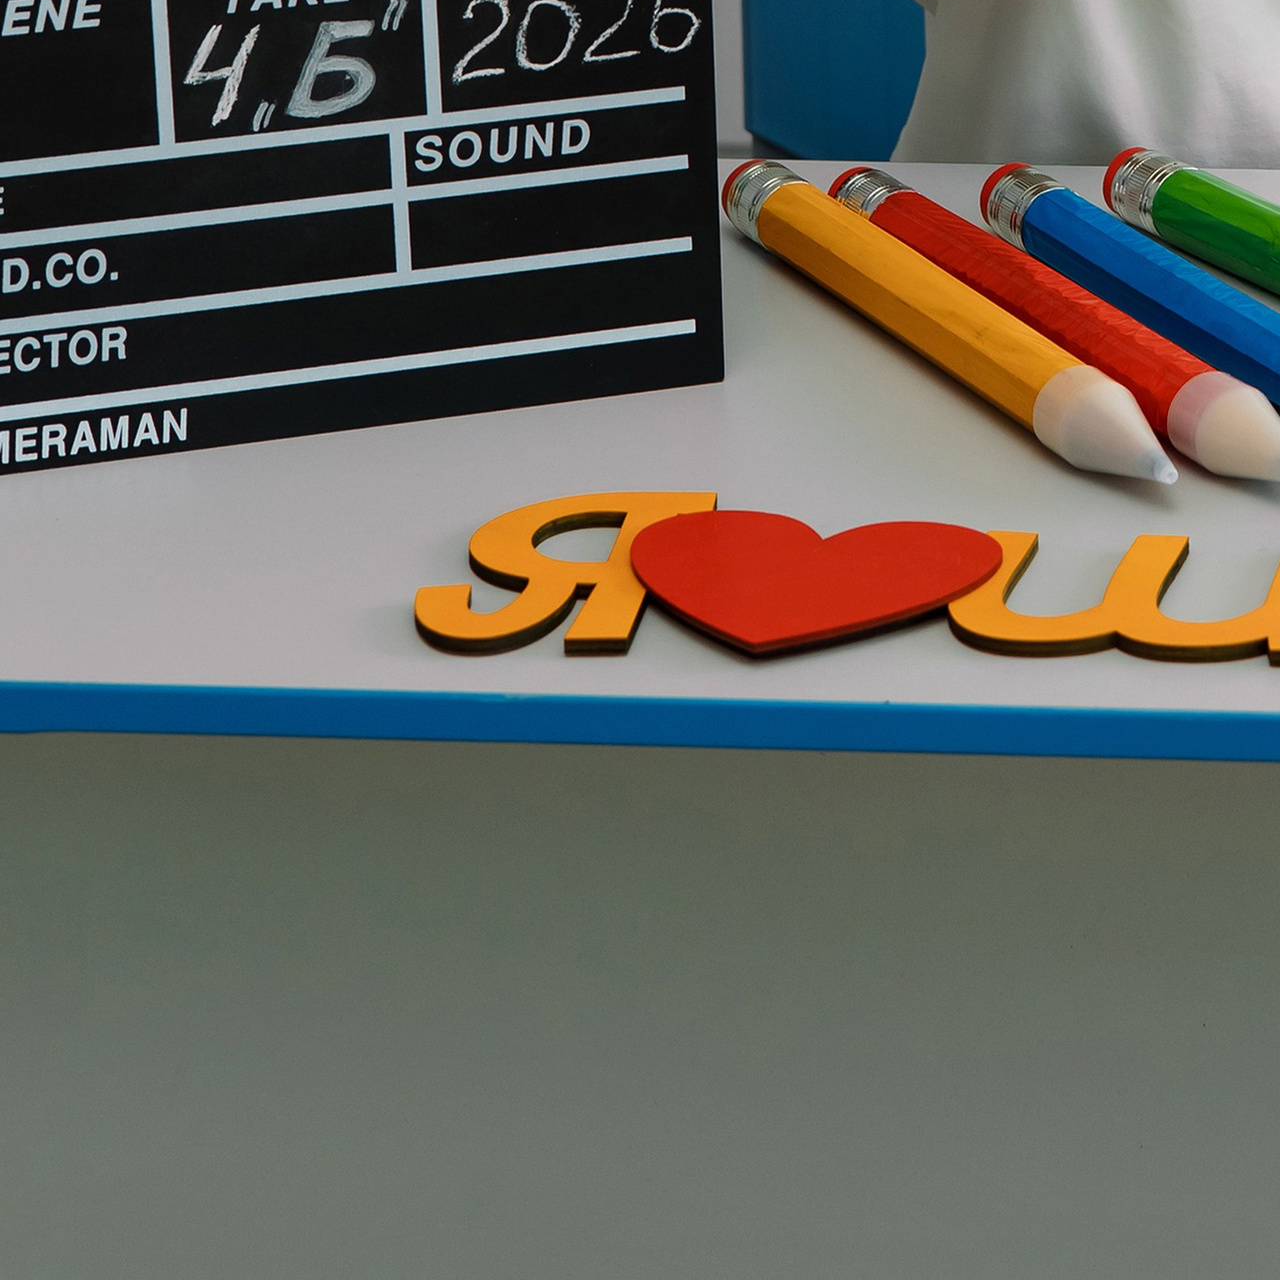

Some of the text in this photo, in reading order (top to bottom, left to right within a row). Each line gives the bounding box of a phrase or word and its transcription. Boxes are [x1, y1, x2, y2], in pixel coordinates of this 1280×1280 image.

[414, 118, 592, 172] SOUND
[2, 248, 120, 294] D.CO.
[414, 491, 719, 657] Я
